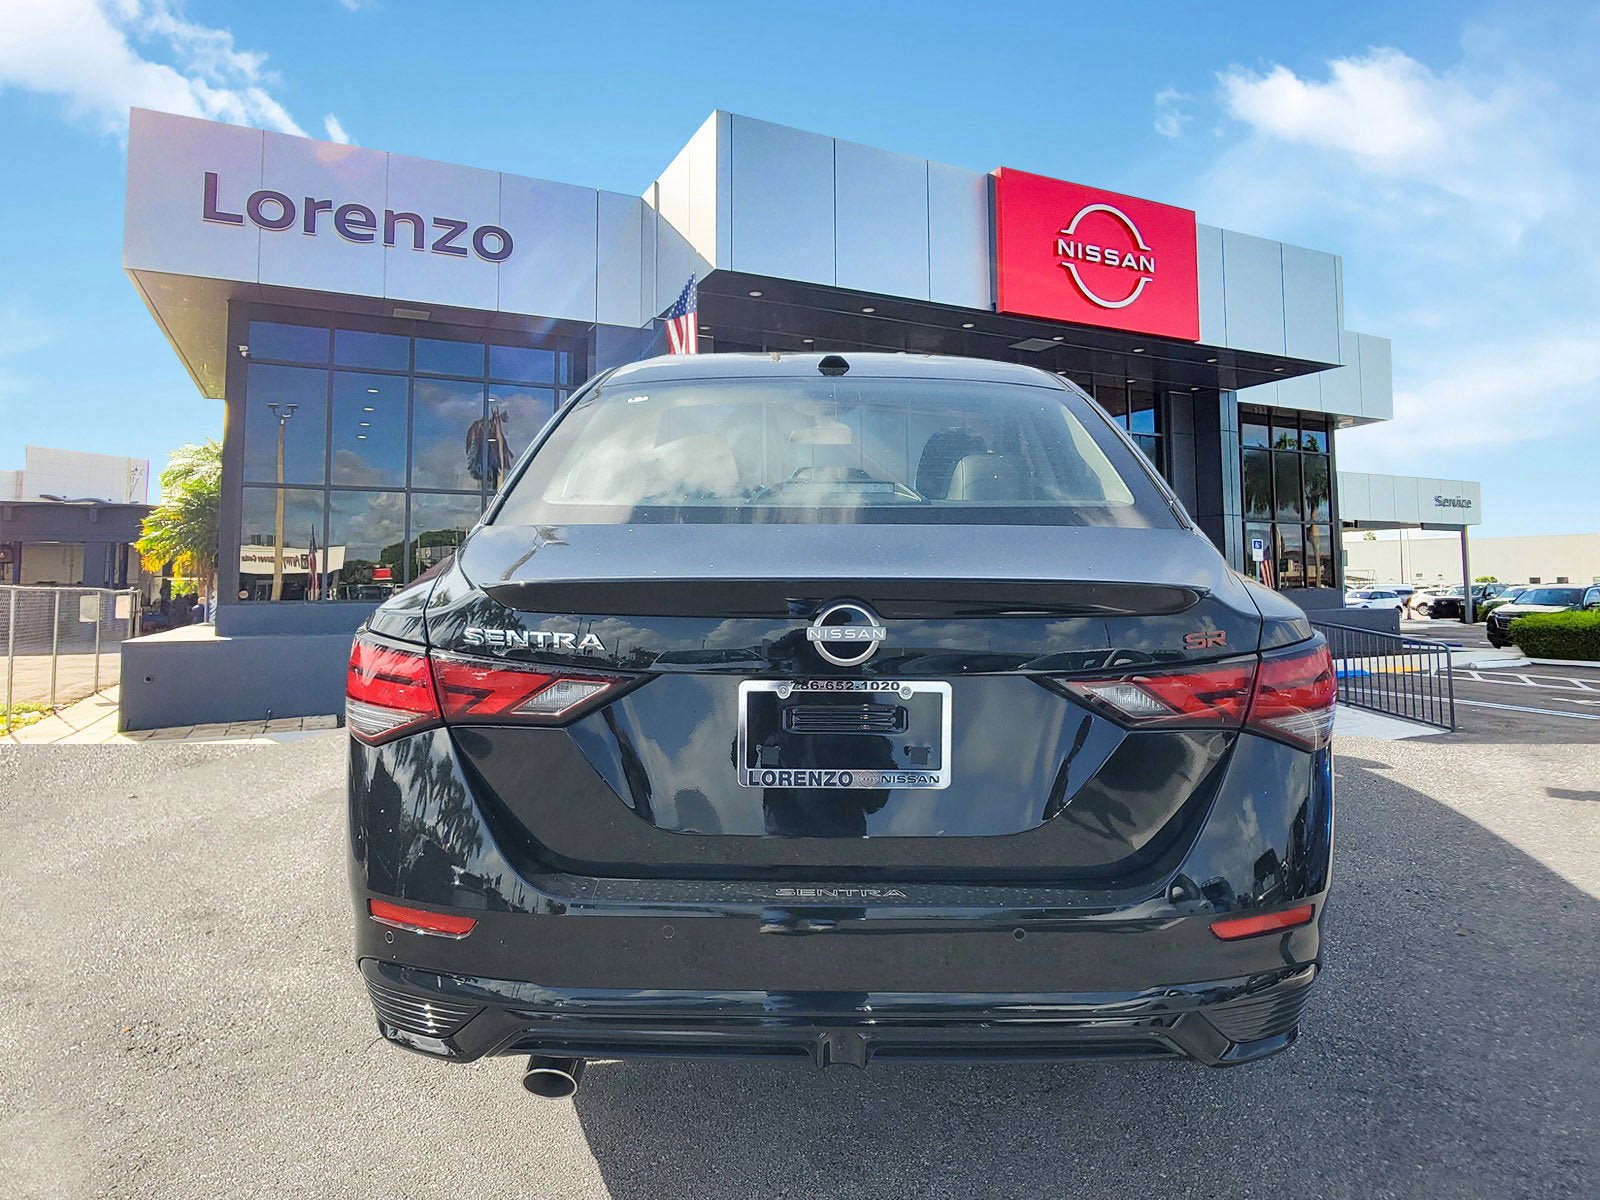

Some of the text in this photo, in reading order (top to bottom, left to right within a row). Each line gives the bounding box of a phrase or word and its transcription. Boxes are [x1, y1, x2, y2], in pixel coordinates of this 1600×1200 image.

[202, 171, 515, 262] Lorenzo
[1057, 238, 1155, 273] NISSAN
[1434, 495, 1472, 509] Service
[463, 627, 606, 651] SENTRA
[809, 628, 884, 639] NISSAN
[1183, 630, 1227, 650] SR
[748, 770, 940, 787] LORENZO NISSAN
[775, 888, 907, 897] SENTRA
